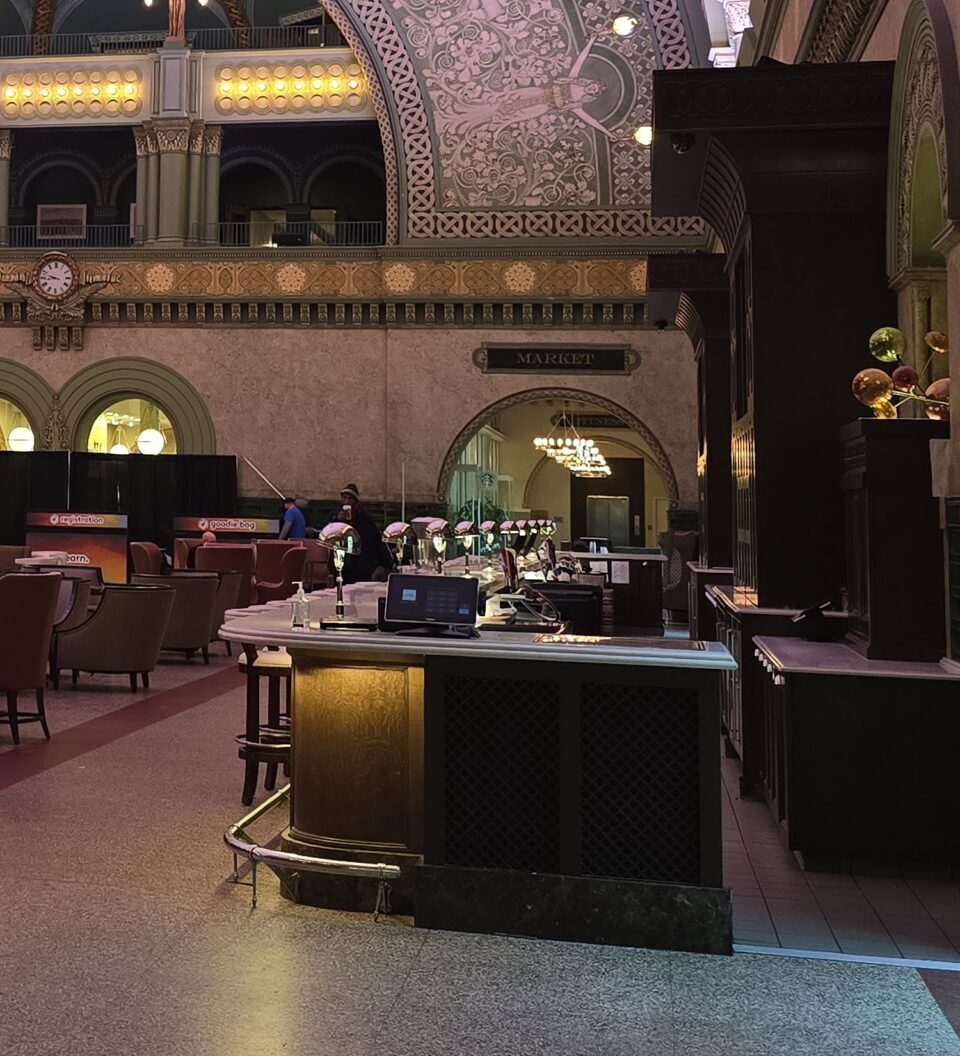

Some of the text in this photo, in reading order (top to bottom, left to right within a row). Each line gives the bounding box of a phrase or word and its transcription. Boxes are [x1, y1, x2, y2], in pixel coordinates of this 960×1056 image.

[515, 352, 595, 365] MARKET
[60, 515, 103, 524] registration
[210, 520, 256, 530] goodie bag
